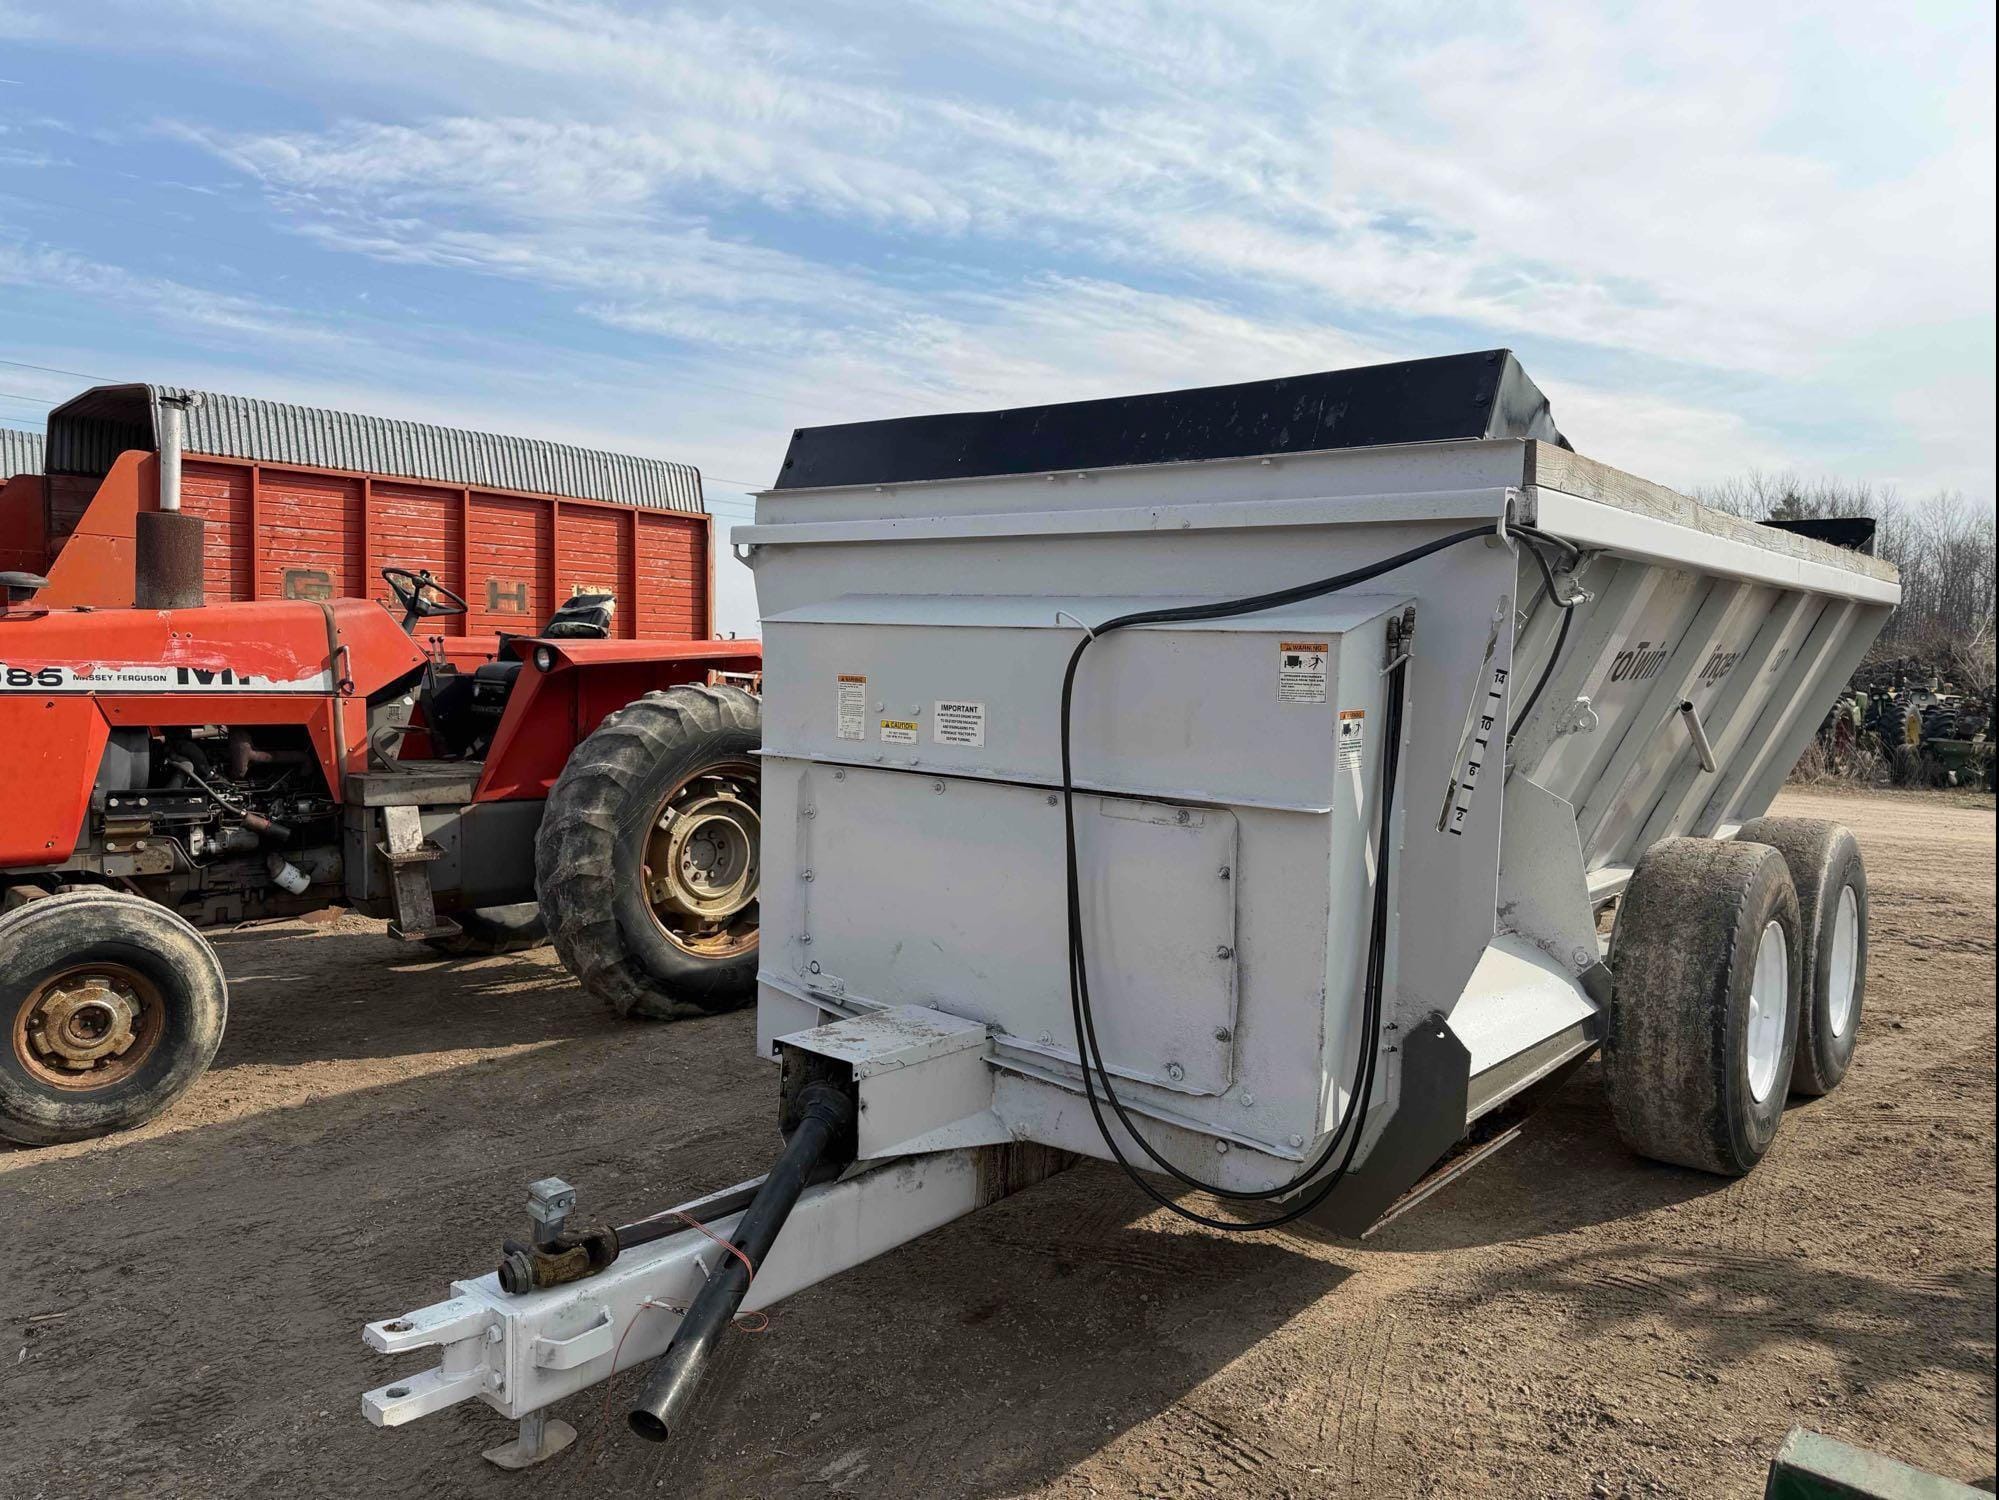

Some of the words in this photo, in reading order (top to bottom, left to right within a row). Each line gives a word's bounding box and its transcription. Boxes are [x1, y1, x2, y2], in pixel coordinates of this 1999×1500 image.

[489, 582, 526, 611] H
[0, 668, 63, 687] 85
[1494, 673, 1506, 685] 14
[941, 704, 978, 713] IMPORTANT
[892, 721, 913, 730] CAUTION
[1480, 720, 1492, 731] 10
[1469, 766, 1476, 776] 6
[1456, 812, 1463, 821] 2
